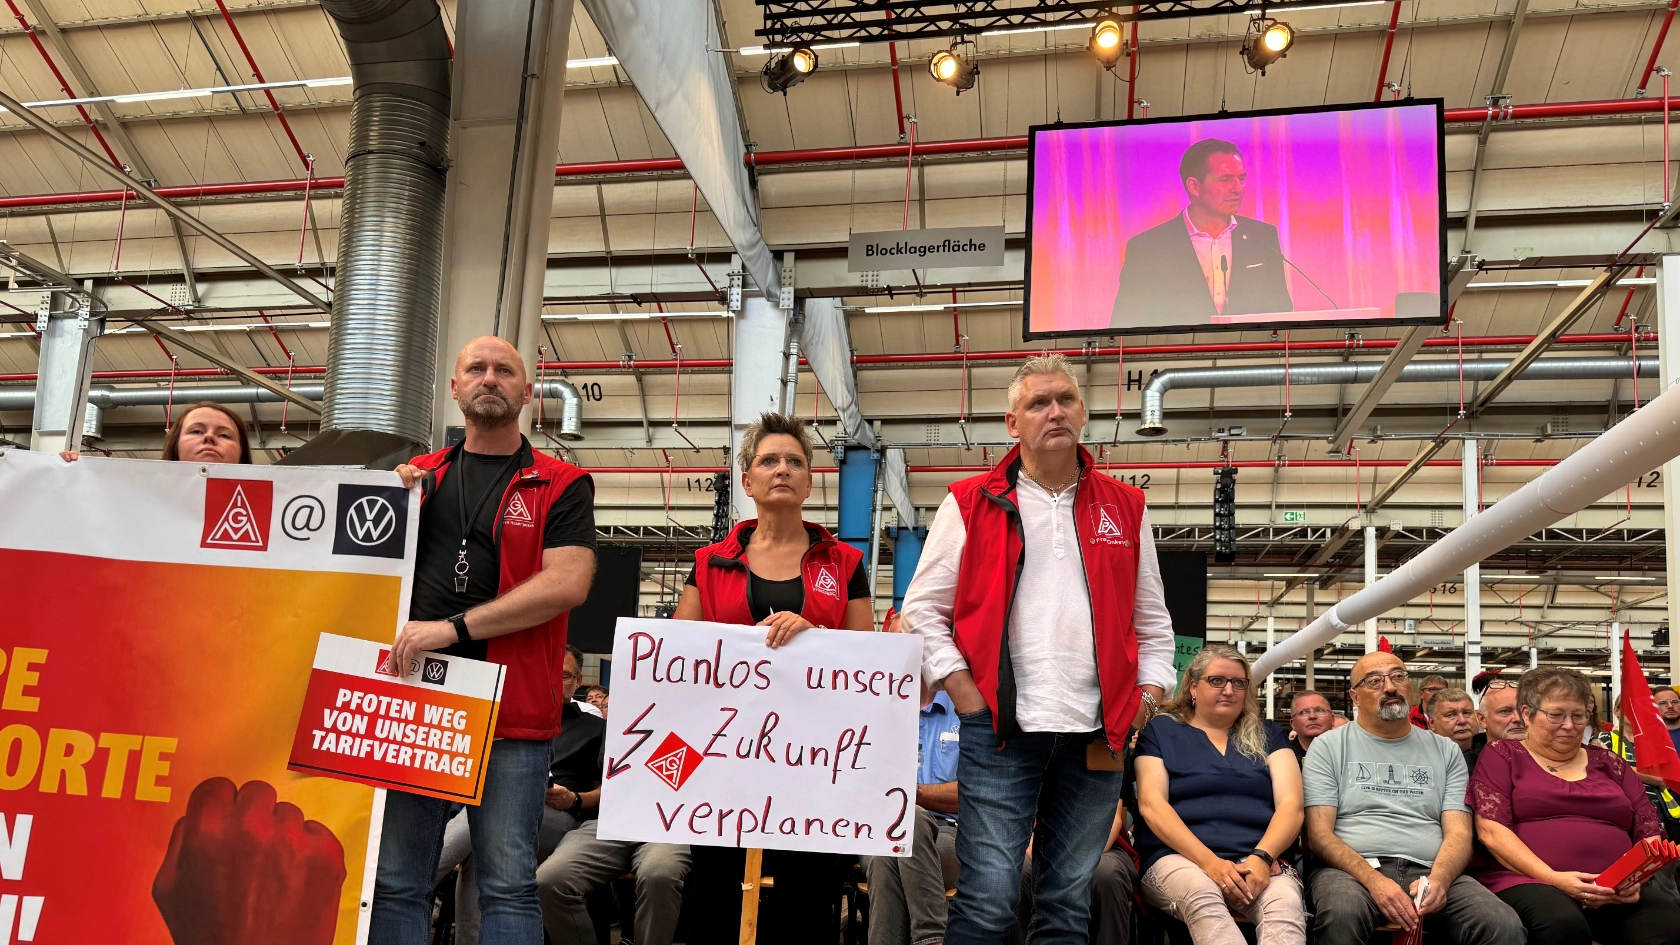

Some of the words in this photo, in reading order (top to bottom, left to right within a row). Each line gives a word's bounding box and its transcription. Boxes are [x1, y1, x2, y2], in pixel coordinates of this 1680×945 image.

[865, 238, 986, 257] Blocklagerfläche
[281, 494, 326, 541] @
[347, 497, 394, 544] VW
[0, 646, 49, 712] E
[627, 631, 773, 690] Planlos
[806, 666, 914, 699] unsere
[323, 708, 368, 735] VON
[374, 718, 471, 754] UNSEREM
[335, 688, 417, 721] PFOTEN
[423, 703, 468, 730] WEG
[311, 729, 473, 778] TARIFVERTRAG!
[702, 707, 872, 784] Zukunft
